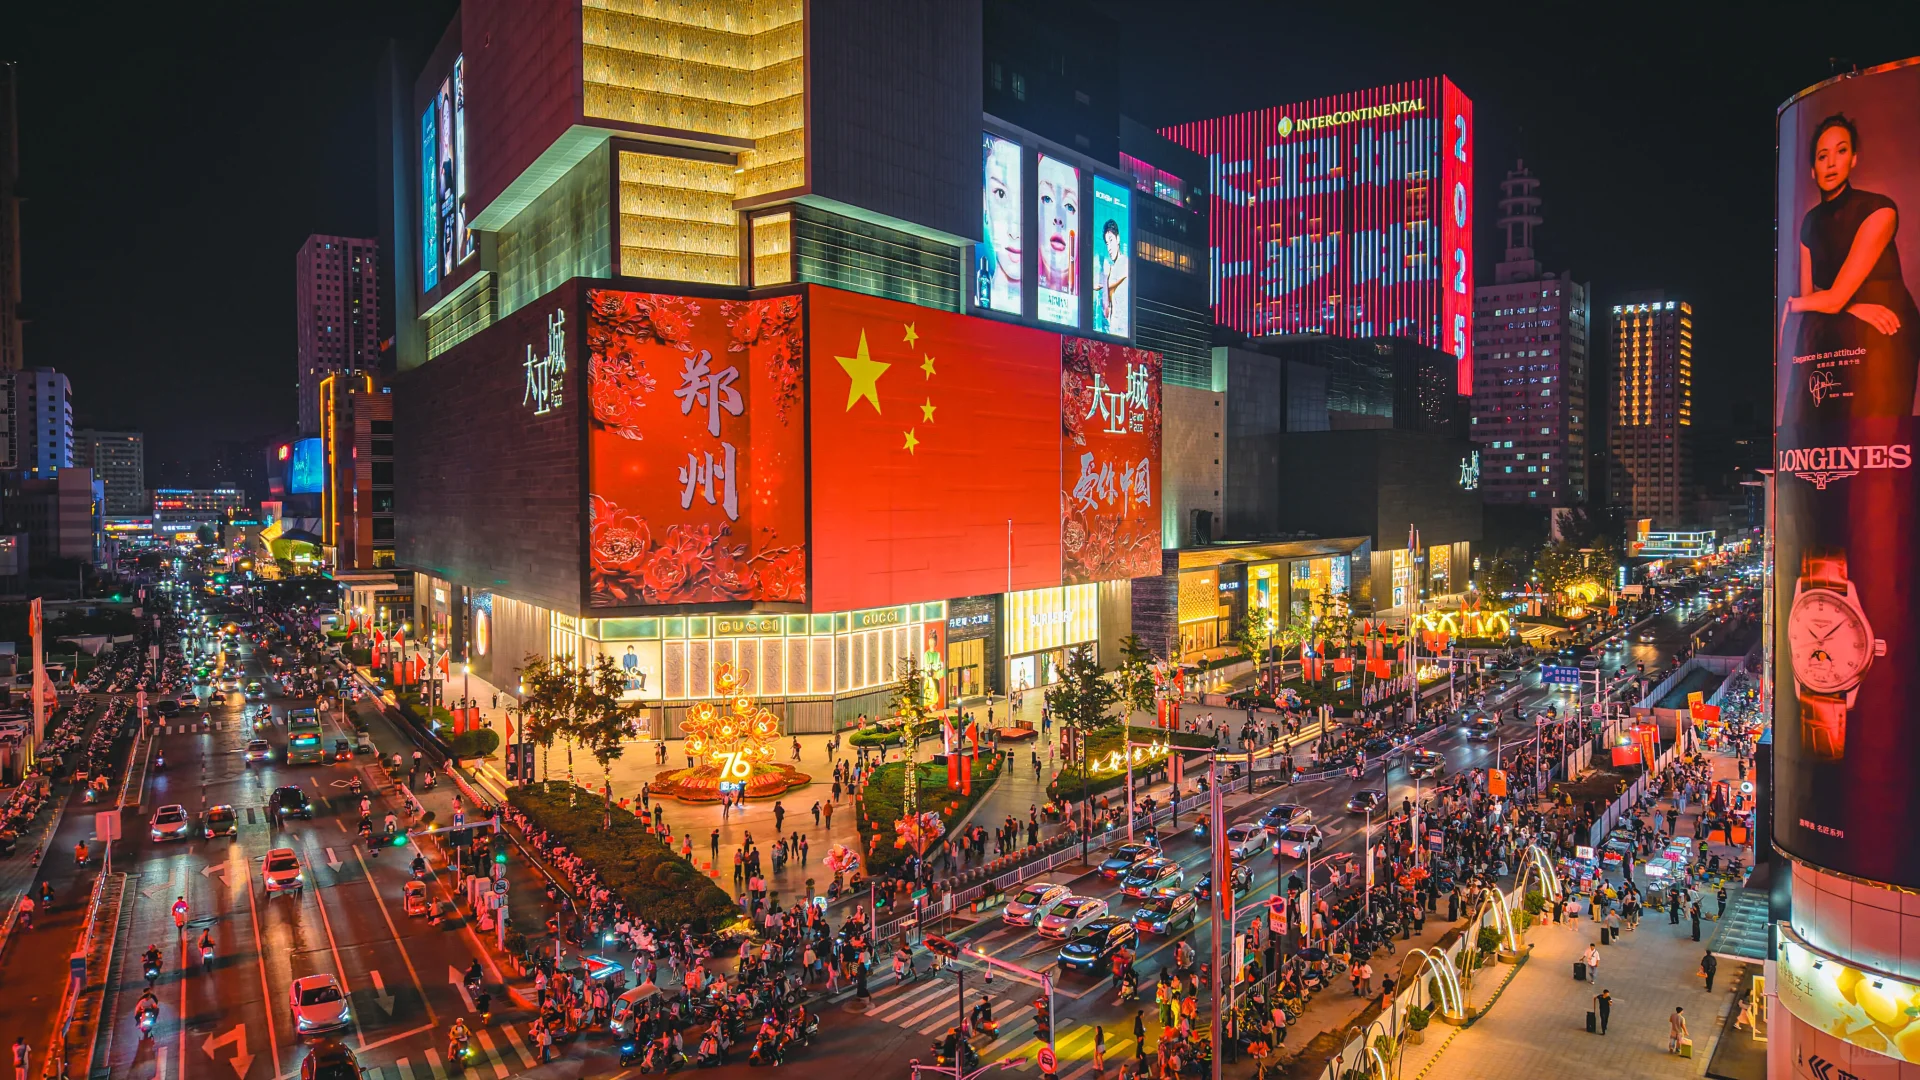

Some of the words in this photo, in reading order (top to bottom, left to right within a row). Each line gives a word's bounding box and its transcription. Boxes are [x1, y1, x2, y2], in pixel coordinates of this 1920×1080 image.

[1296, 98, 1425, 132] INTERCONTINENTAL
[523, 307, 566, 415] 大卫城
[1816, 352, 1822, 360] is
[1823, 351, 1832, 359] an
[1833, 347, 1867, 358] attitude
[1085, 363, 1149, 434] 大卫城
[673, 349, 744, 521] 郑州
[1779, 444, 1912, 472] LONGINES
[718, 620, 779, 633] GUCCI
[862, 612, 898, 626] GUCCI
[720, 752, 751, 779] 76
